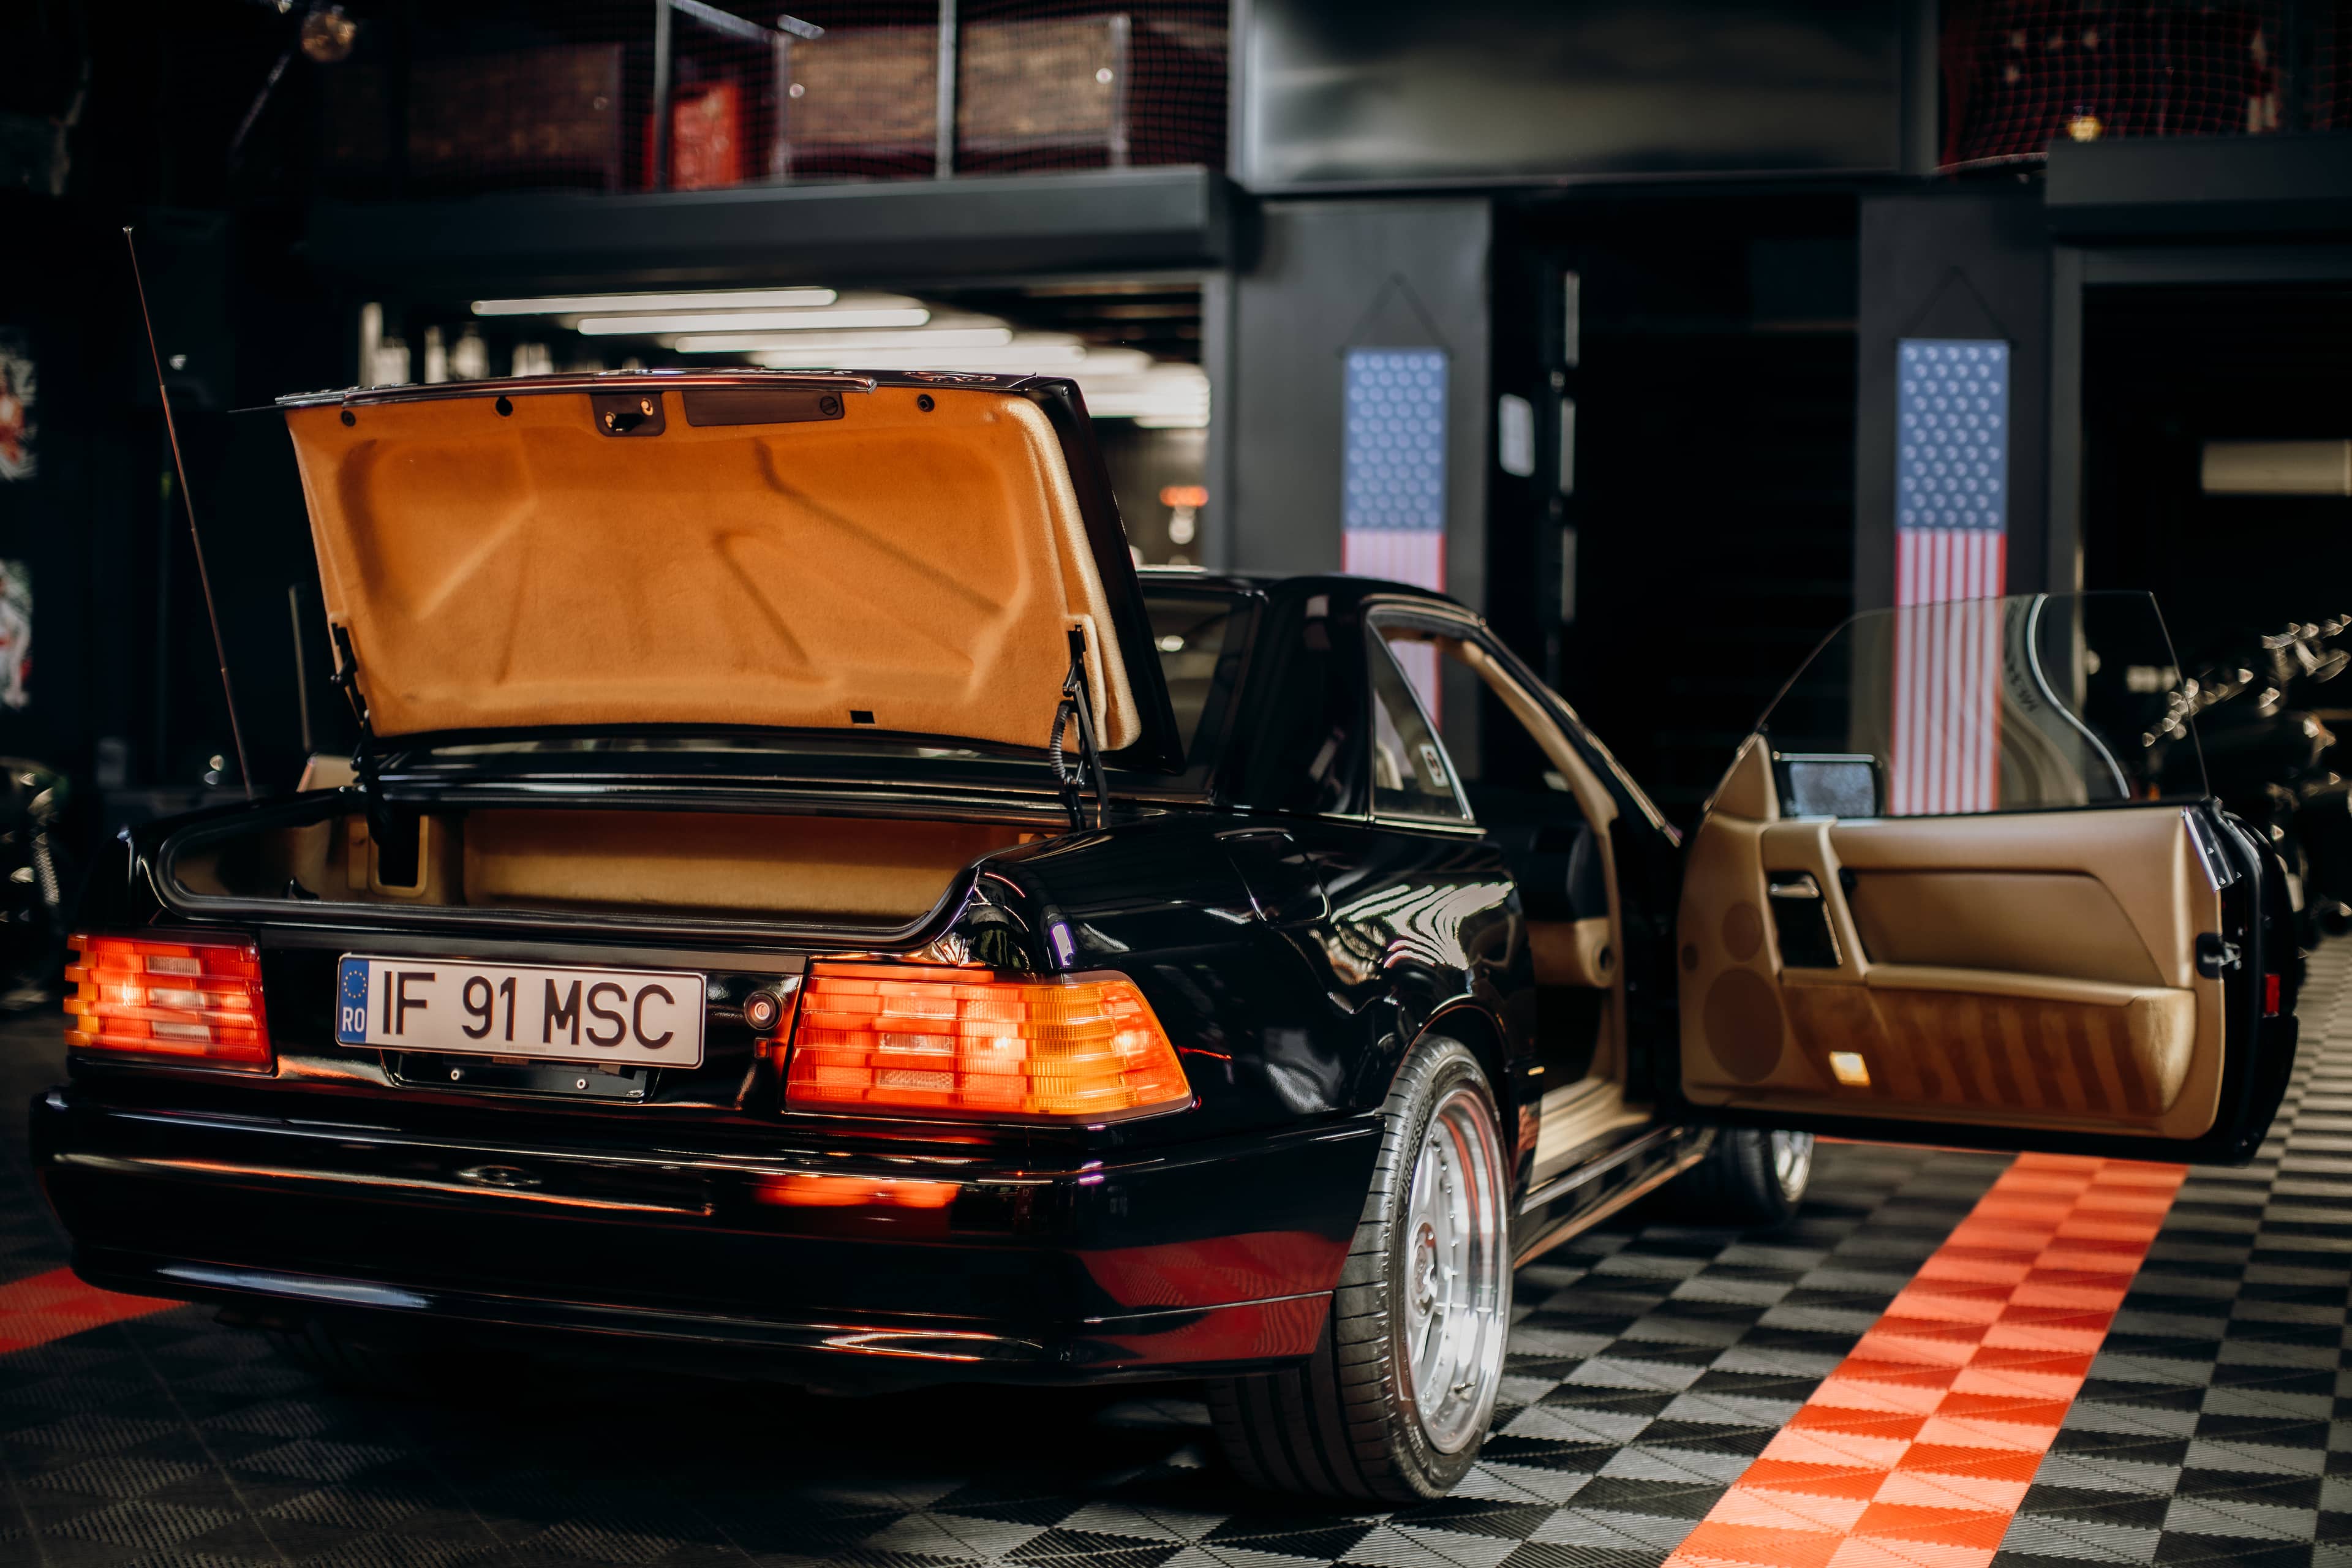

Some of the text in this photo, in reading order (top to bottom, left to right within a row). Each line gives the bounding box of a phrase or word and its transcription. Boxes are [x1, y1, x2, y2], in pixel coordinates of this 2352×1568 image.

[342, 1006, 365, 1032] RO
[383, 971, 675, 1049] IF 91 MSC
